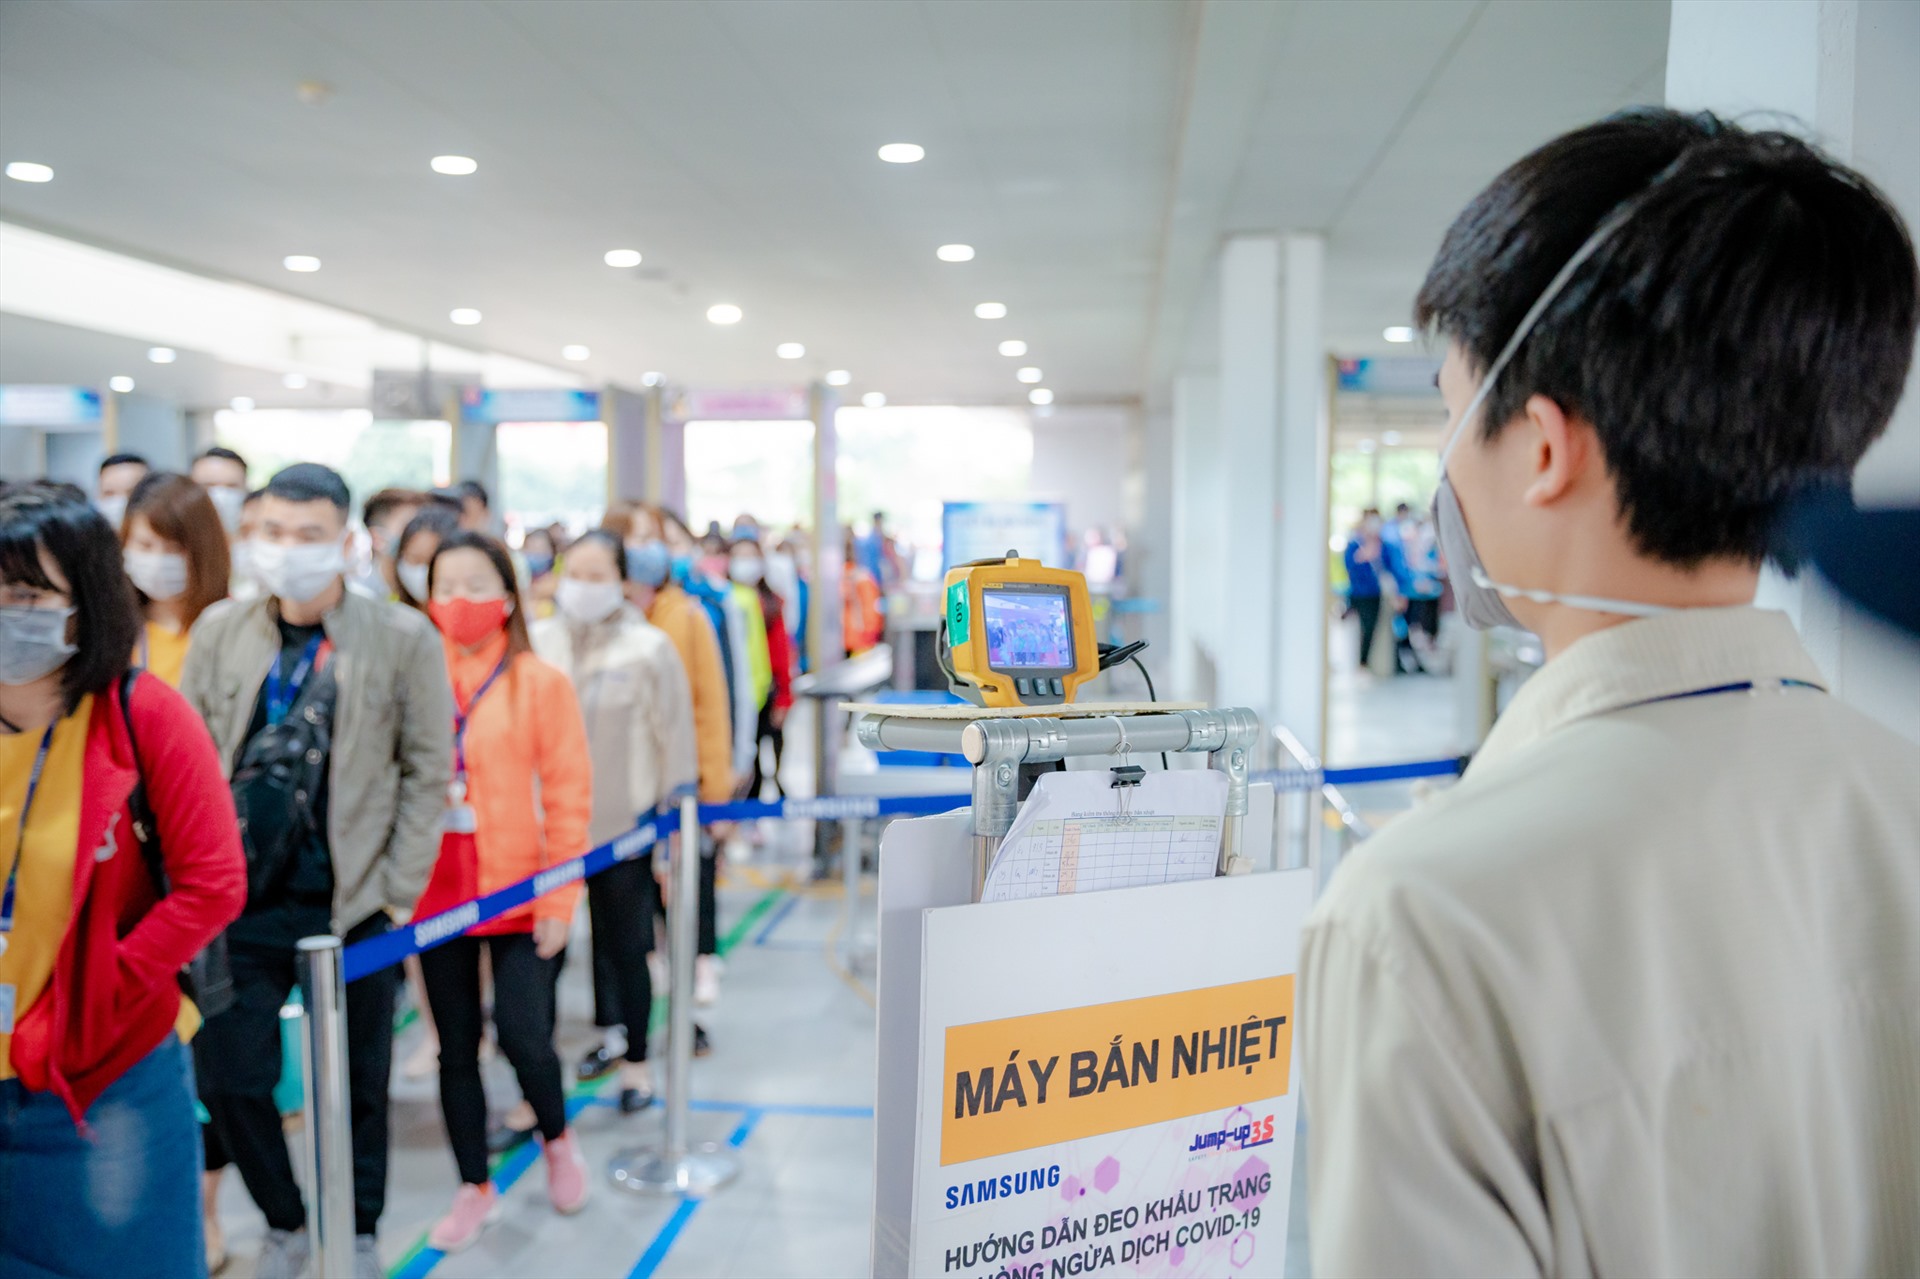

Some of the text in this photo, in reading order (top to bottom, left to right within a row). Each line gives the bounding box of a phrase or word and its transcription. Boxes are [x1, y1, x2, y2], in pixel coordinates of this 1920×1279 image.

[955, 1014, 1286, 1119] MÁY BẮN NHIỆT
[945, 1165, 1060, 1209] SAMSUNG
[945, 1172, 1271, 1272] HƯỚNG DẪN ĐEO KHẨU TRANG
[1051, 1244, 1115, 1279] NGỪA
[1121, 1230, 1170, 1265] DỊCH
[1175, 1206, 1261, 1248] COVID-19
